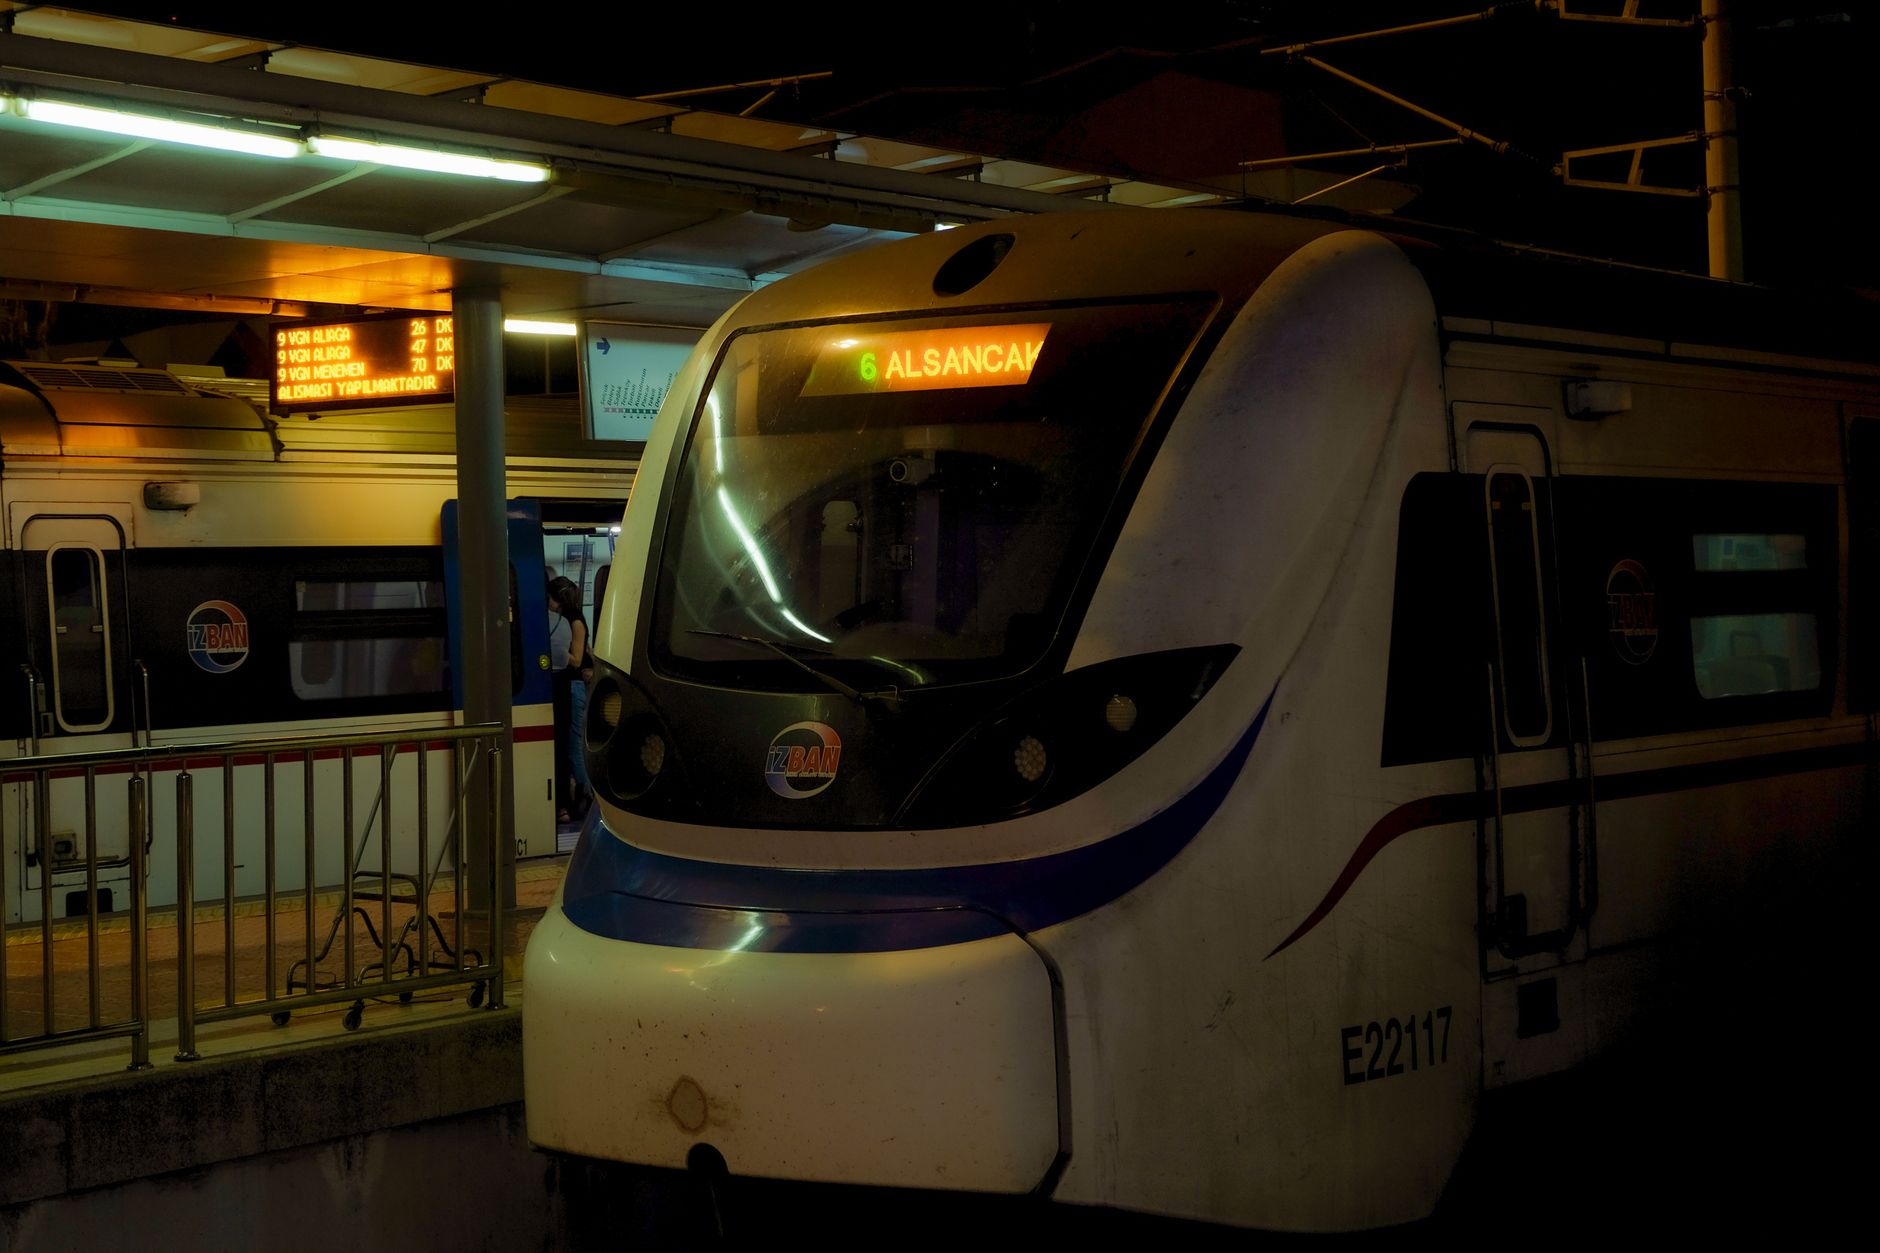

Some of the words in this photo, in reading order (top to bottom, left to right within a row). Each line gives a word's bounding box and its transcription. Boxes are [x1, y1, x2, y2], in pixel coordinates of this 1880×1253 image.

[277, 332, 286, 346] 9
[288, 330, 310, 345] VGN
[411, 321, 426, 335] 26
[436, 318, 452, 333] DK
[277, 350, 286, 364] 9
[289, 349, 310, 363] VGN
[411, 339, 426, 353] 47
[436, 337, 452, 352] DK
[278, 368, 286, 382] 9
[289, 367, 310, 381] VGN
[313, 362, 365, 379] MENEMEN
[412, 358, 426, 372] 70
[436, 356, 453, 371] DK
[860, 352, 877, 380] 6
[337, 375, 437, 395] YAPILMAKTADIR
[1341, 1005, 1453, 1086] E22117
